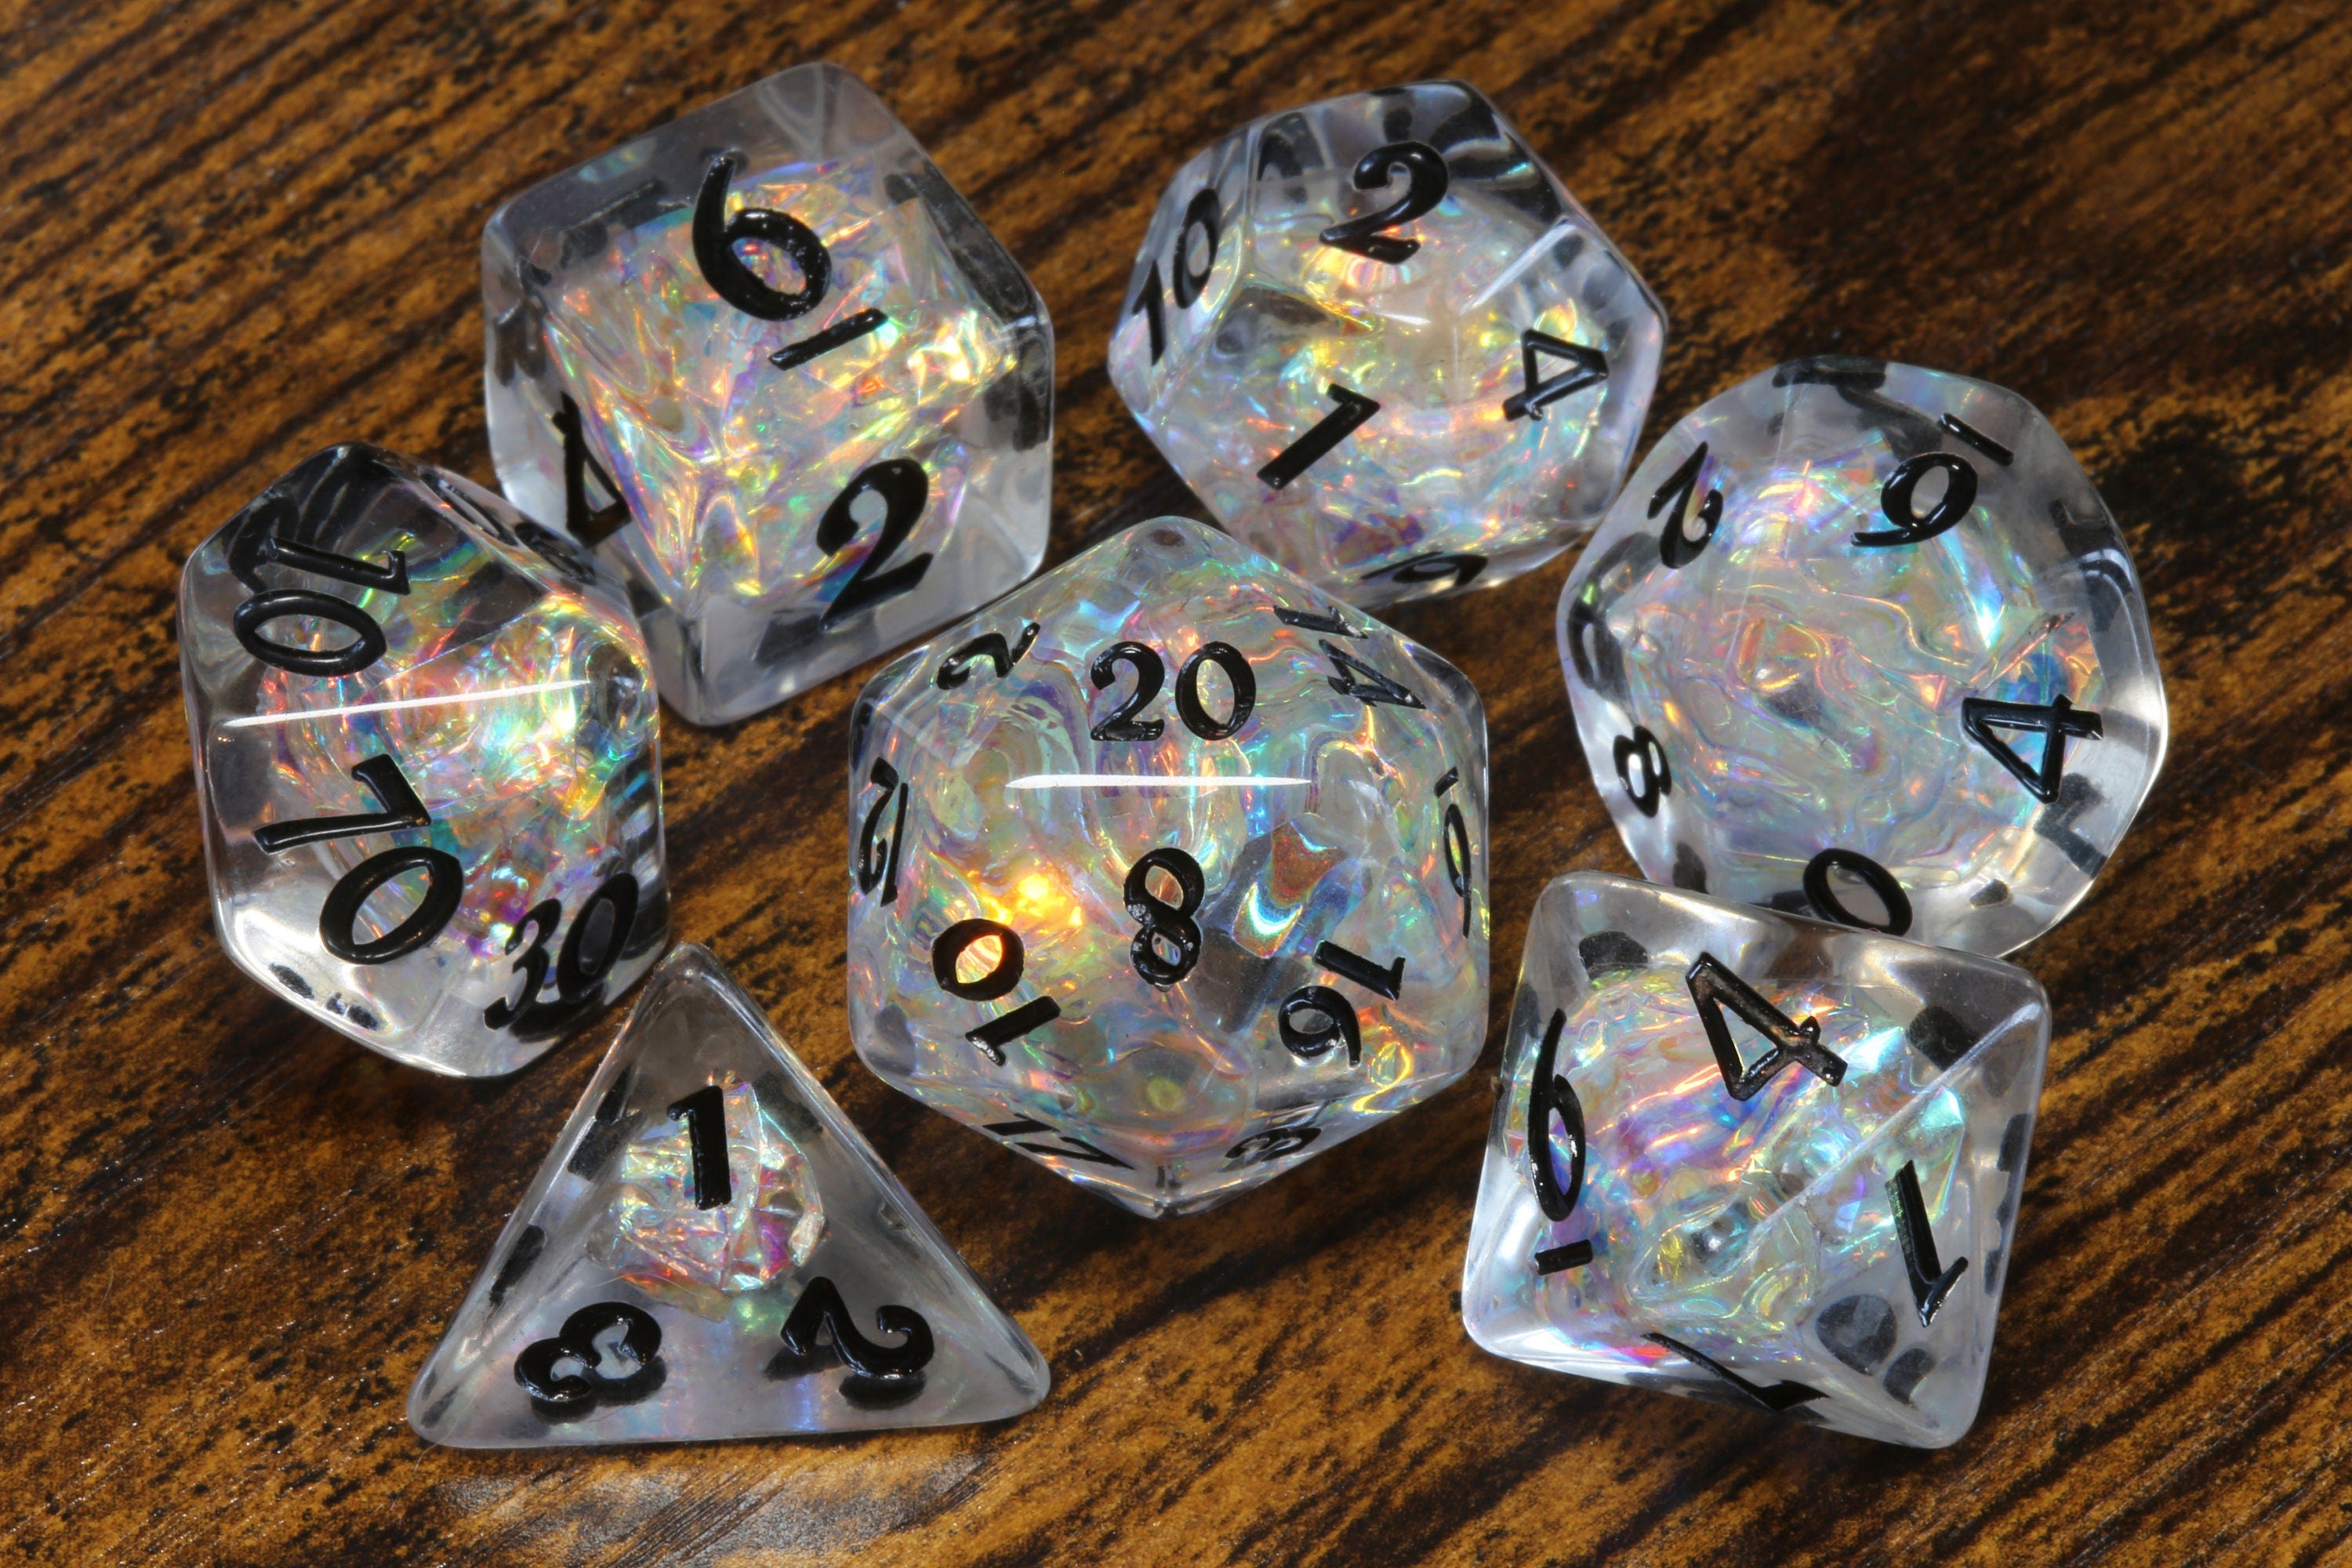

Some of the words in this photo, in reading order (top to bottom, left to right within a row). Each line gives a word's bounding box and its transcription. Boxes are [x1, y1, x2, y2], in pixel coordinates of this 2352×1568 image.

[692, 156, 832, 321] 6
[1319, 141, 1449, 264] 2
[1134, 188, 1220, 366] 10
[1502, 328, 1610, 421] 4
[551, 390, 633, 548] 4
[1648, 442, 1723, 568] 2
[233, 536, 411, 677] 10
[816, 458, 934, 629] 2
[937, 622, 1040, 690] 2
[1090, 641, 1256, 741] 20
[1273, 604, 1427, 710] 14
[1613, 725, 1671, 818] 8
[1962, 694, 2104, 804] 4
[253, 753, 464, 965] 70
[858, 757, 910, 908] 12
[1803, 848, 1913, 936] 0
[484, 872, 639, 1031] 30
[1123, 848, 1206, 987] 8
[931, 918, 1062, 1067] 10
[1278, 941, 1406, 1067] 16
[1686, 951, 1849, 1101] 4
[666, 1086, 732, 1210] 1
[1528, 1007, 1586, 1222] 6
[514, 1301, 662, 1403] 3
[781, 1276, 935, 1379] 2
